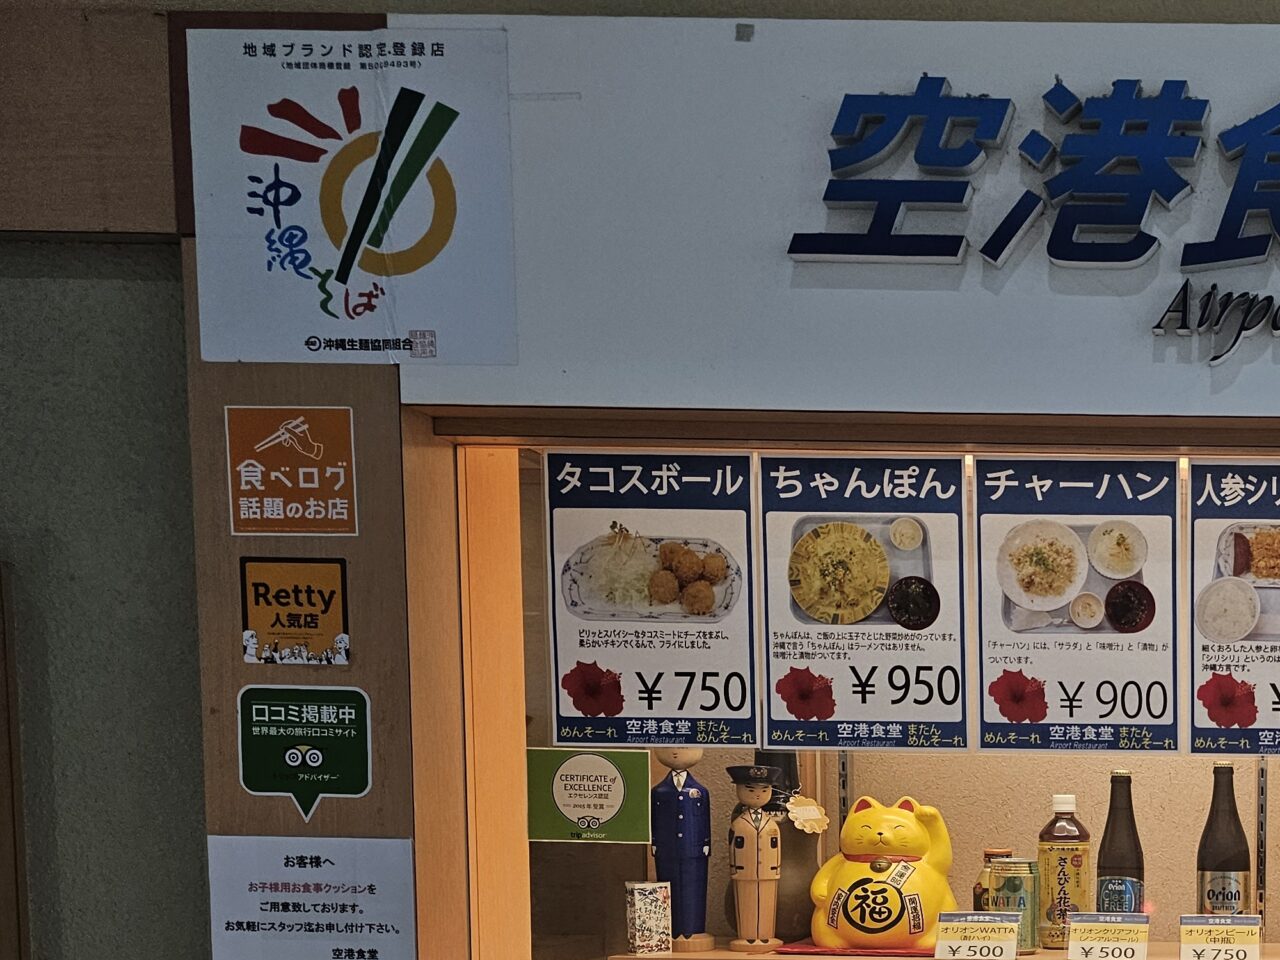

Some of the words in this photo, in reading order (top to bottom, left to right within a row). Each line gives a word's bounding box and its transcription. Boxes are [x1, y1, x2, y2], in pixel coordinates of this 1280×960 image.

[236, 459, 347, 490] 食べログ
[557, 462, 743, 496] タコスボール
[770, 465, 956, 499] ちゃんぽん
[984, 469, 1169, 501] チャーハン
[238, 497, 348, 520] 話題のお店
[251, 582, 337, 614] Retty
[270, 612, 319, 629] 人気店
[988, 656, 1033, 665] ついています。
[635, 671, 746, 711] ¥750
[848, 665, 960, 706] ¥950
[1057, 680, 1168, 719] ¥900
[252, 705, 356, 724] 口コミ掲載中
[252, 726, 357, 738] 世界最大の旅行口コミサイト
[560, 726, 617, 738] めんそーれ
[626, 719, 691, 735] 空港食堂
[697, 721, 730, 731] またん
[837, 723, 902, 738] 空港食堂
[907, 724, 941, 735] またん
[697, 731, 753, 742] めんそーれ
[772, 730, 829, 742] めんそーれ
[984, 732, 1041, 744] めんそーれ
[1049, 725, 1114, 740] 空港食堂
[1119, 727, 1153, 738] またん
[907, 735, 964, 746] めんそーれ
[1119, 738, 1175, 749] めんそーれ
[1194, 737, 1250, 749] めんそーれ
[560, 774, 608, 782] CERTIFICATE
[610, 776, 617, 784] of
[564, 784, 612, 792] EXCELLENCE
[284, 855, 335, 868] お客様へ
[248, 882, 376, 894] お子様用お食事クッションを
[1207, 886, 1240, 901] Orion
[1102, 891, 1131, 901] Clear
[259, 902, 364, 914] ご用意致しております。
[851, 887, 892, 924] 福
[1104, 902, 1129, 911] FREE
[225, 921, 400, 934] お気軽にスタッフ迄お申し付け下さい。
[1185, 929, 1257, 937] オリオンビール
[332, 948, 378, 960] 空港食堂
